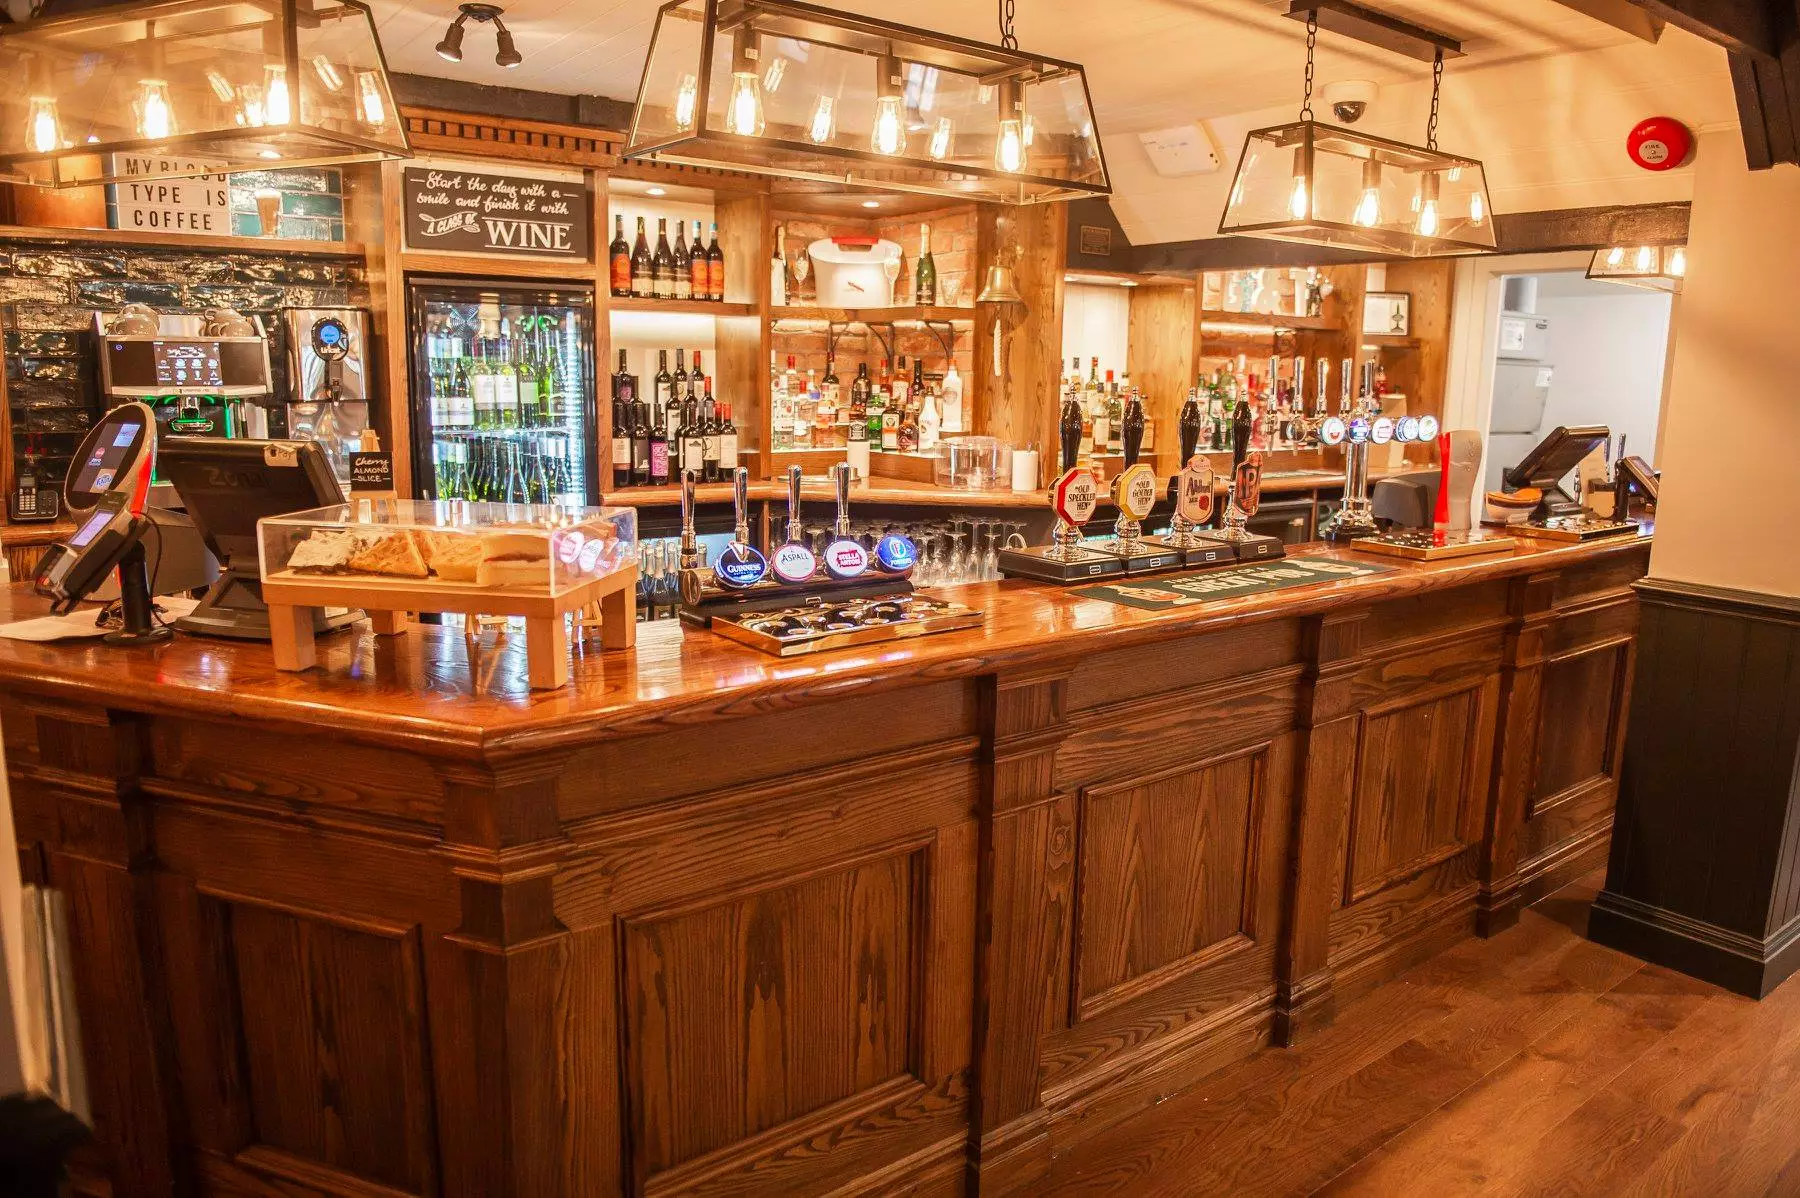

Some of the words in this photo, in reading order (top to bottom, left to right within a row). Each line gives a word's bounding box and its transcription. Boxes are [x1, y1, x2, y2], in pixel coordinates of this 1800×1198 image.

[125, 158, 152, 175] MY
[426, 171, 462, 189] Start
[467, 177, 488, 191] the
[491, 180, 518, 198] day
[520, 184, 547, 197] with
[551, 189, 562, 199] a
[130, 184, 181, 203] TYPE
[206, 189, 226, 206] IS
[416, 192, 450, 205] smile
[455, 195, 481, 208] and
[482, 195, 520, 213] finish
[524, 199, 537, 212] it
[541, 202, 570, 215] with
[133, 209, 212, 230] COFFEE
[427, 221, 435, 234] A
[436, 213, 463, 233] GLASS
[485, 220, 572, 250] WINE
[355, 456, 390, 469] Cherry
[358, 475, 382, 483] SLICE
[1068, 493, 1096, 502] SPECKLED
[781, 552, 810, 563] ASPALL
[726, 563, 762, 574] GUINNESS
